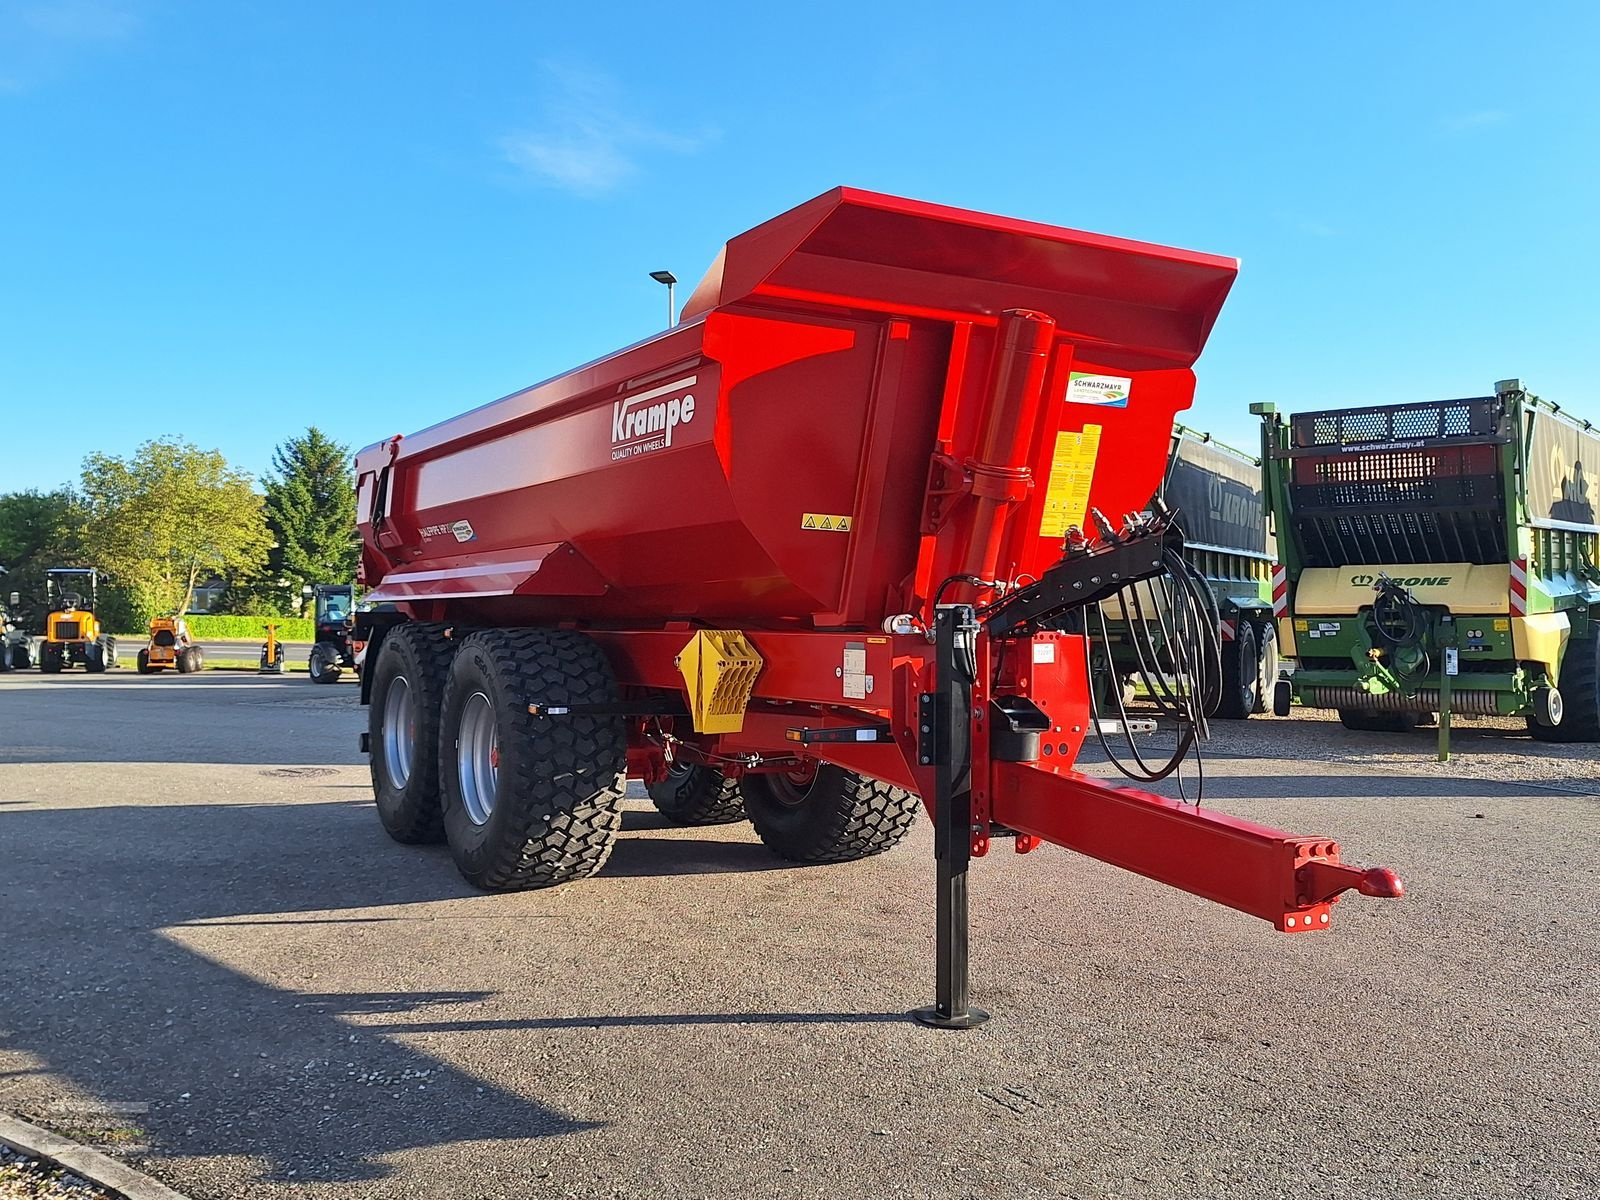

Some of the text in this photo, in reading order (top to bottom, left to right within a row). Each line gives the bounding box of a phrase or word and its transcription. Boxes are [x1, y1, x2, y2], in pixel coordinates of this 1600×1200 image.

[1073, 379, 1122, 391] SCHWARZMAYR
[611, 375, 697, 448] Krampe
[611, 438, 665, 461] QUALITY ON WHEELS
[1341, 439, 1425, 453] www.schwarzmayr.at
